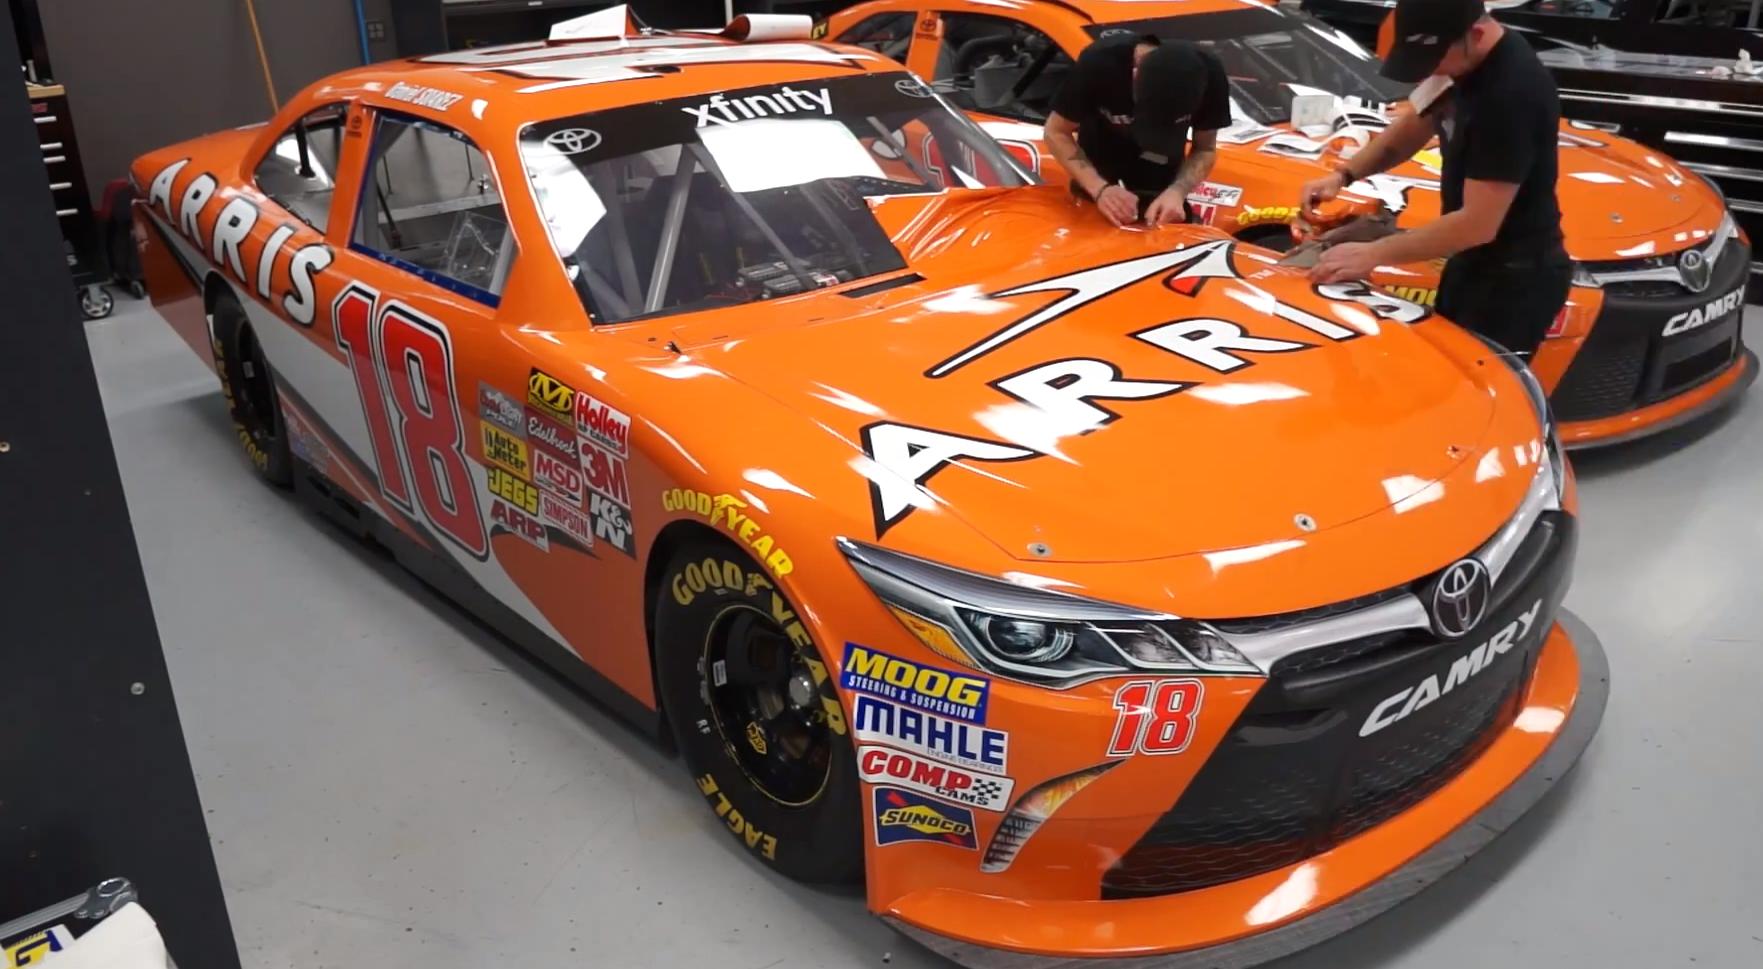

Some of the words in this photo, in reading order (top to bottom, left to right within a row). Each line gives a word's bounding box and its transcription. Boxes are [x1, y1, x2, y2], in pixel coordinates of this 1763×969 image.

[683, 86, 834, 128] xfinity
[148, 158, 334, 328] ARRIS
[1662, 284, 1746, 337] CAMRY
[332, 280, 489, 562] 18
[577, 393, 627, 454] Holley
[859, 279, 1433, 541] ARRIS
[487, 469, 539, 517] JEGS
[536, 456, 581, 493] MSD
[581, 443, 630, 506] 3M
[490, 499, 547, 543] ARP
[845, 648, 986, 707] MOOG
[849, 675, 896, 697] STEERING
[911, 692, 976, 720] SUSPENSION
[1359, 599, 1542, 737] CAMRY
[856, 696, 1005, 766] MAHLE
[1106, 678, 1204, 757] 18
[862, 751, 973, 790] COMP
[935, 786, 990, 807] CAMS
[697, 774, 778, 860] EAGLE
[881, 810, 969, 834] SUNOCO
